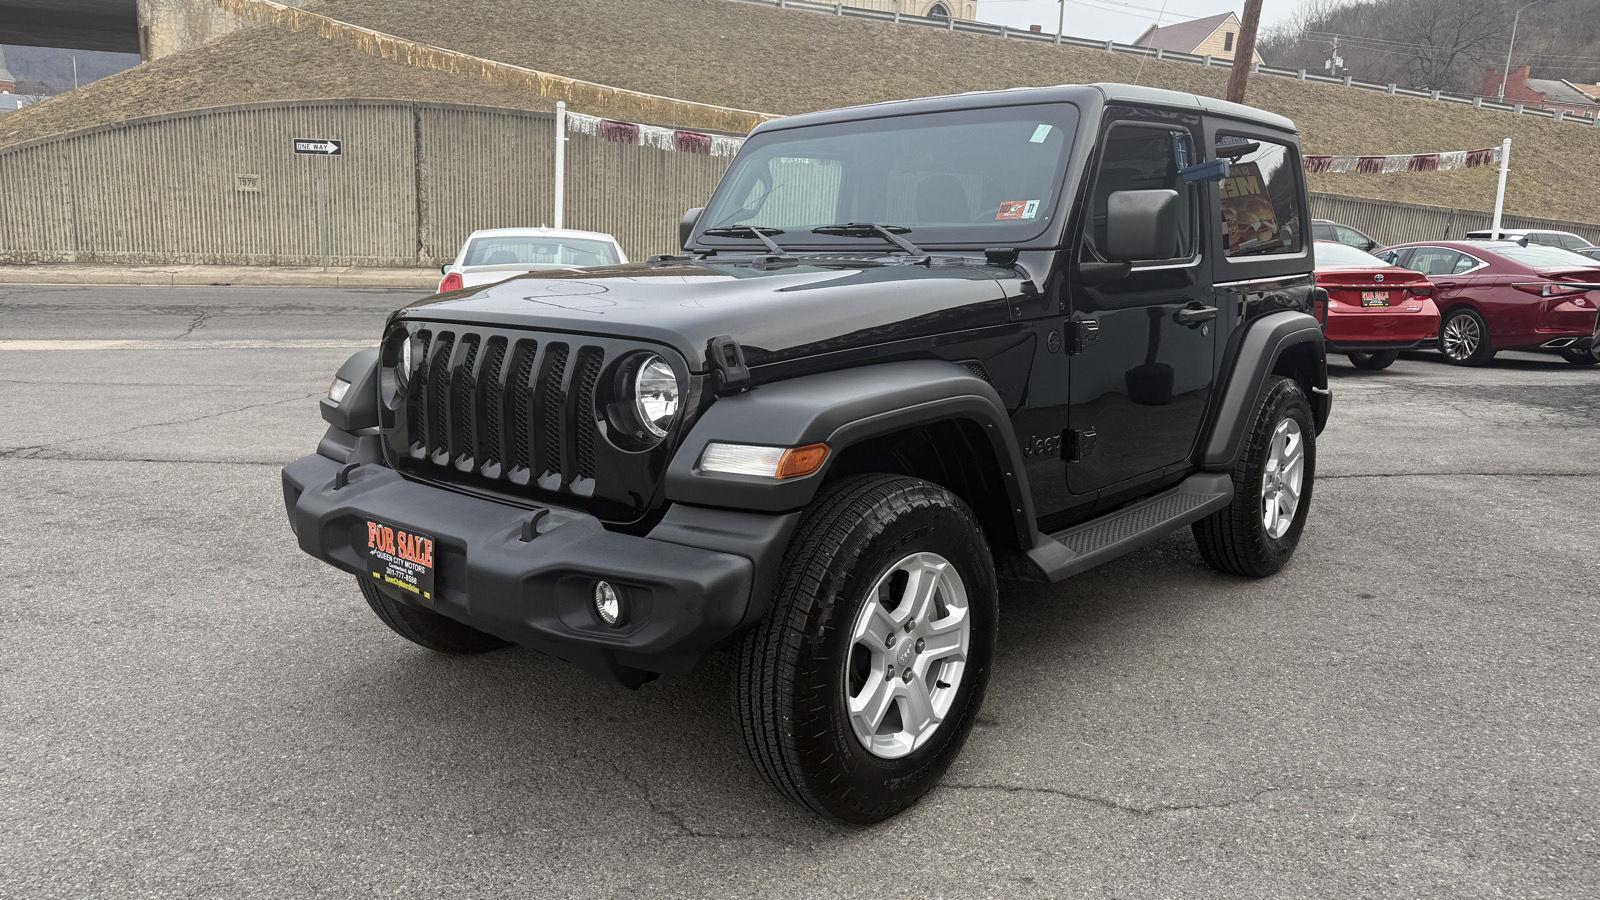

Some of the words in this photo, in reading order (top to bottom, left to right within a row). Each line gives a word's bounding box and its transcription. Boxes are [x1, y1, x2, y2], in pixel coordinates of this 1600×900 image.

[367, 521, 396, 556] FOR
[397, 531, 433, 568] SALE
[377, 551, 393, 563] QUEEN
[393, 556, 405, 565] CITY
[404, 560, 426, 574] MOTORS
